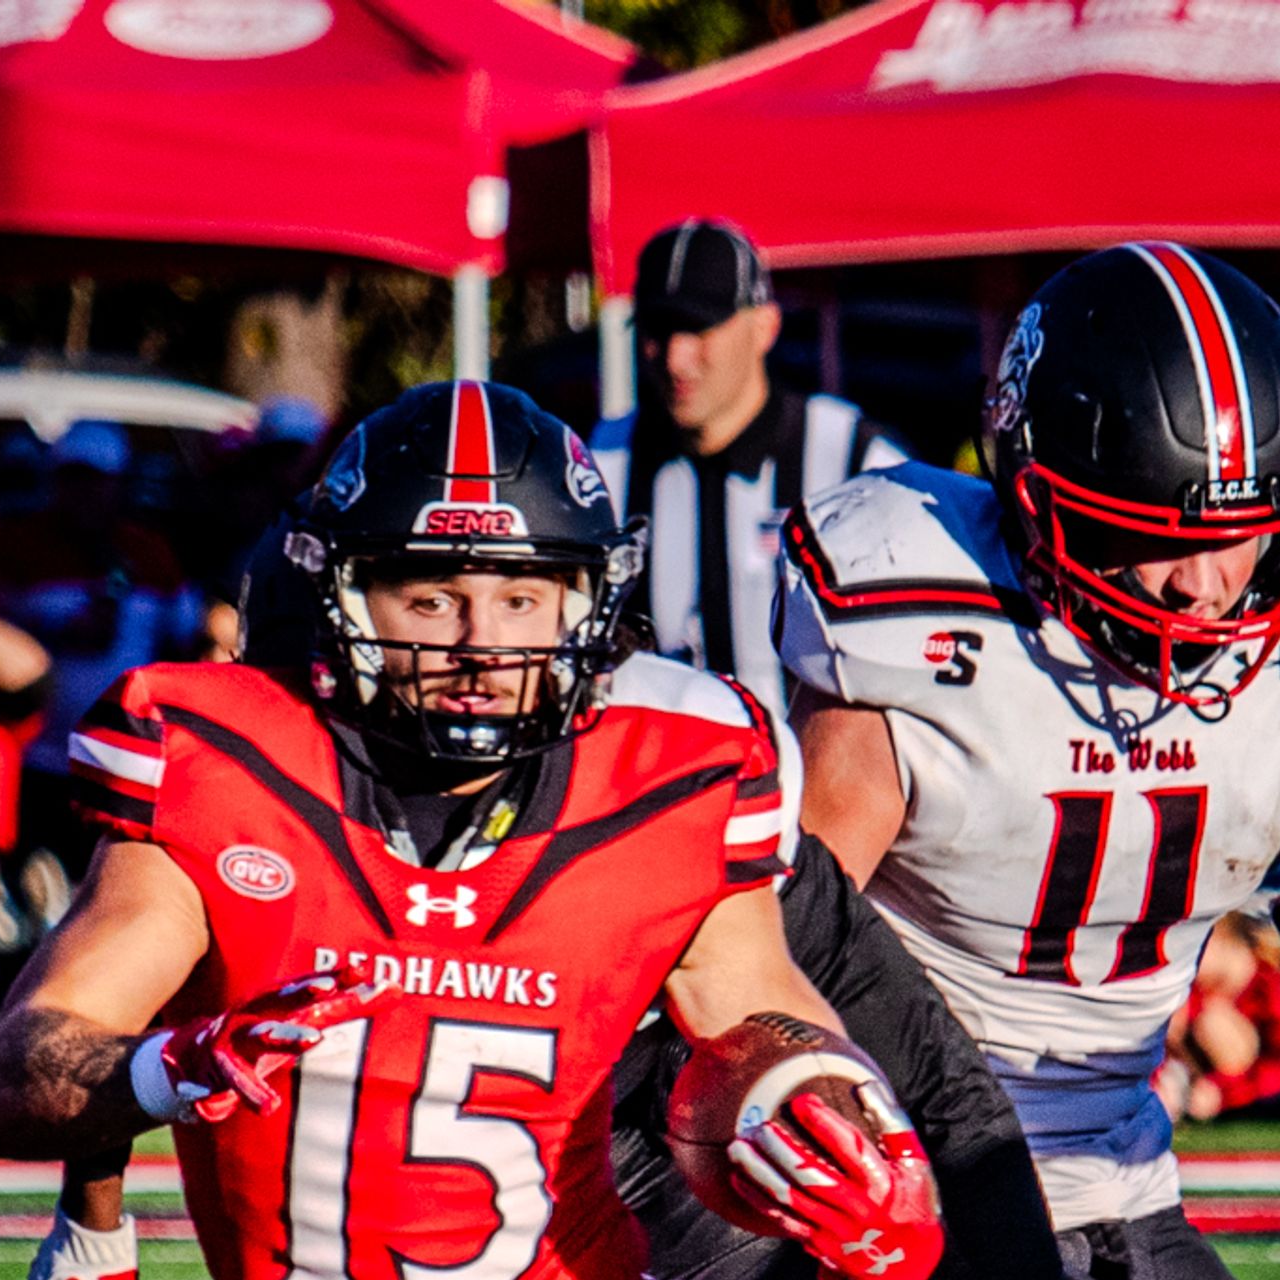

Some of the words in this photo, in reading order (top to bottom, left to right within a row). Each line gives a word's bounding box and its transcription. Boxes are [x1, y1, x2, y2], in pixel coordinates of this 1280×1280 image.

[426, 509, 513, 535] SEMO
[1069, 739, 1115, 773] The
[1127, 738, 1197, 772] Webb
[232, 860, 276, 887] OVC
[1003, 785, 1208, 986] 11
